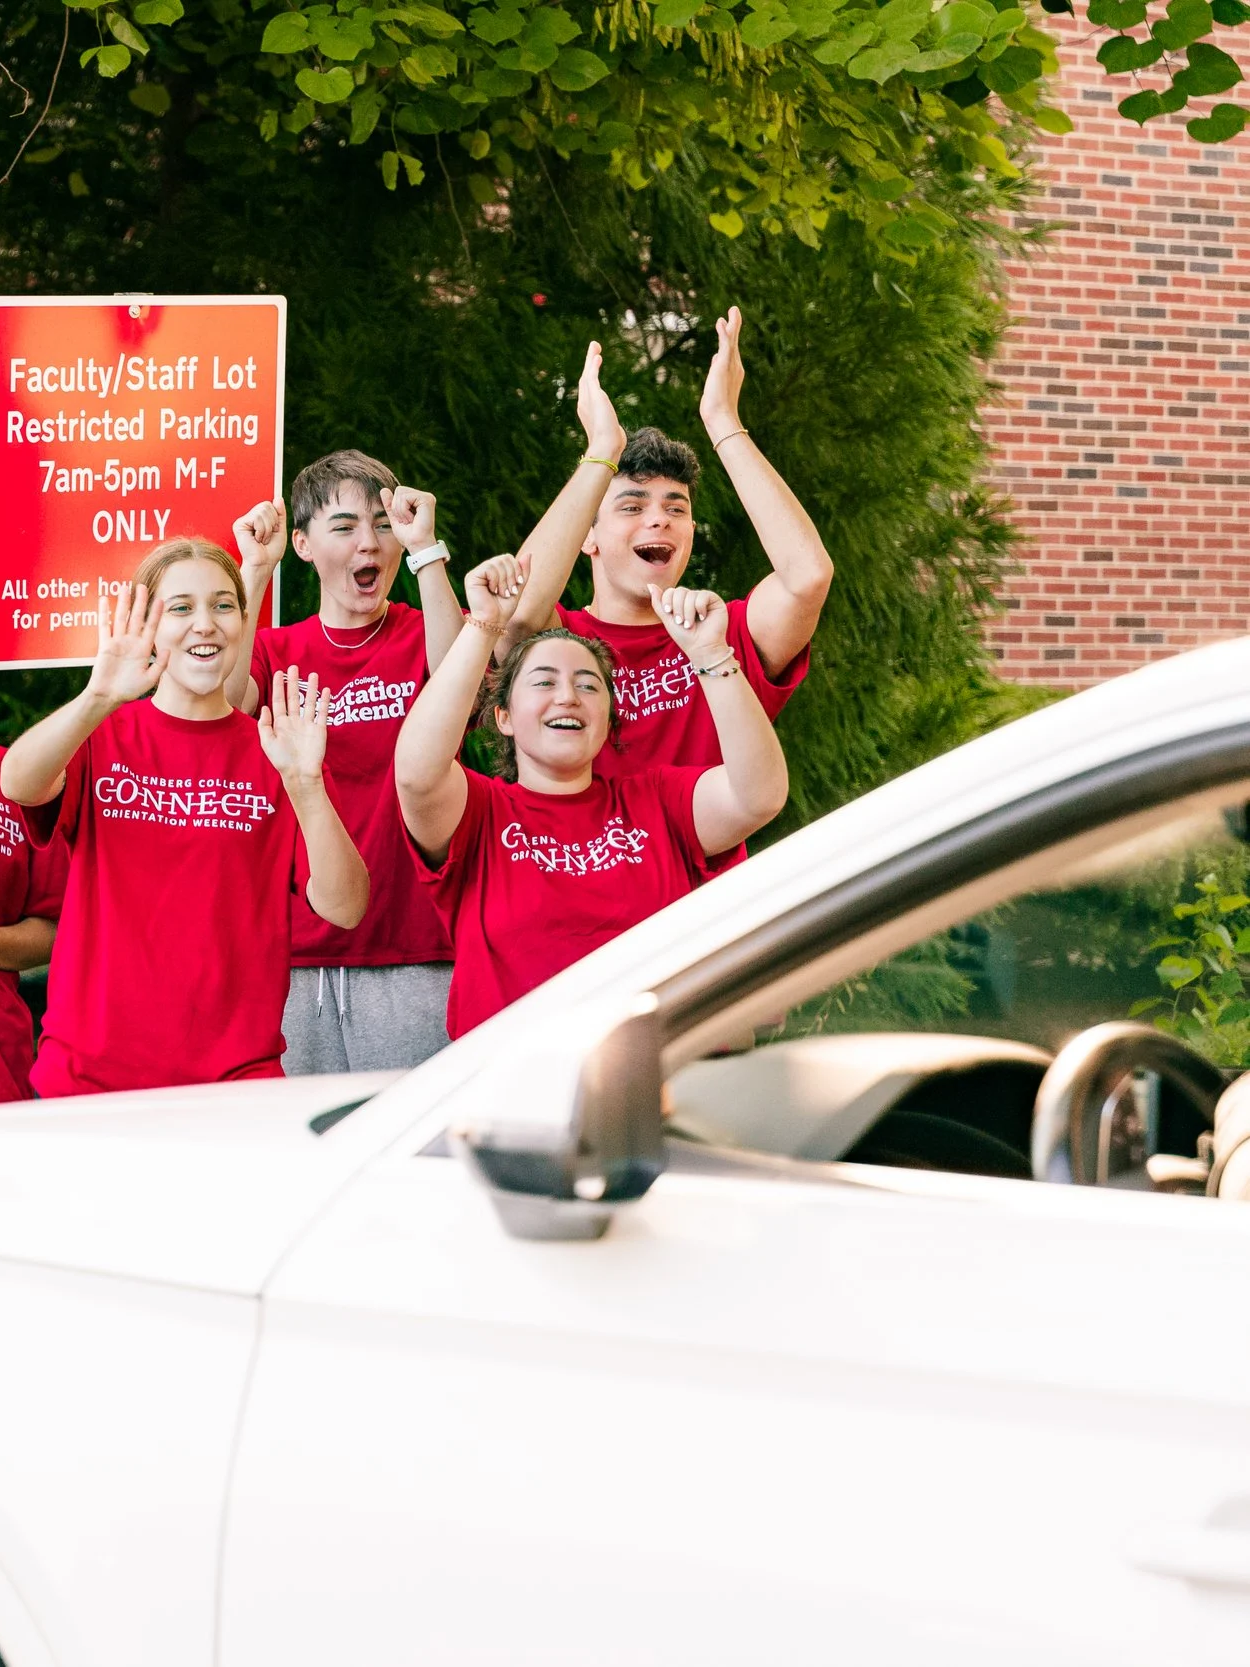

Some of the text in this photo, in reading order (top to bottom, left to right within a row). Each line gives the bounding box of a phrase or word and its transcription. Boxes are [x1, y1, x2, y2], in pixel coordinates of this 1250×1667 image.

[10, 353, 257, 398] Faculty/Staff Lot
[7, 407, 258, 445] Restricted Parking
[39, 456, 226, 496] 7am-5pm M-F
[92, 509, 171, 543] ONLY
[2, 576, 133, 600] All other hou
[12, 609, 111, 631] for perm
[301, 698, 406, 727] eekend
[111, 762, 252, 790] MULENBERG COLLEGE
[95, 777, 267, 820] CONNECT
[103, 808, 252, 832] ORIENTATION WEEKEND
